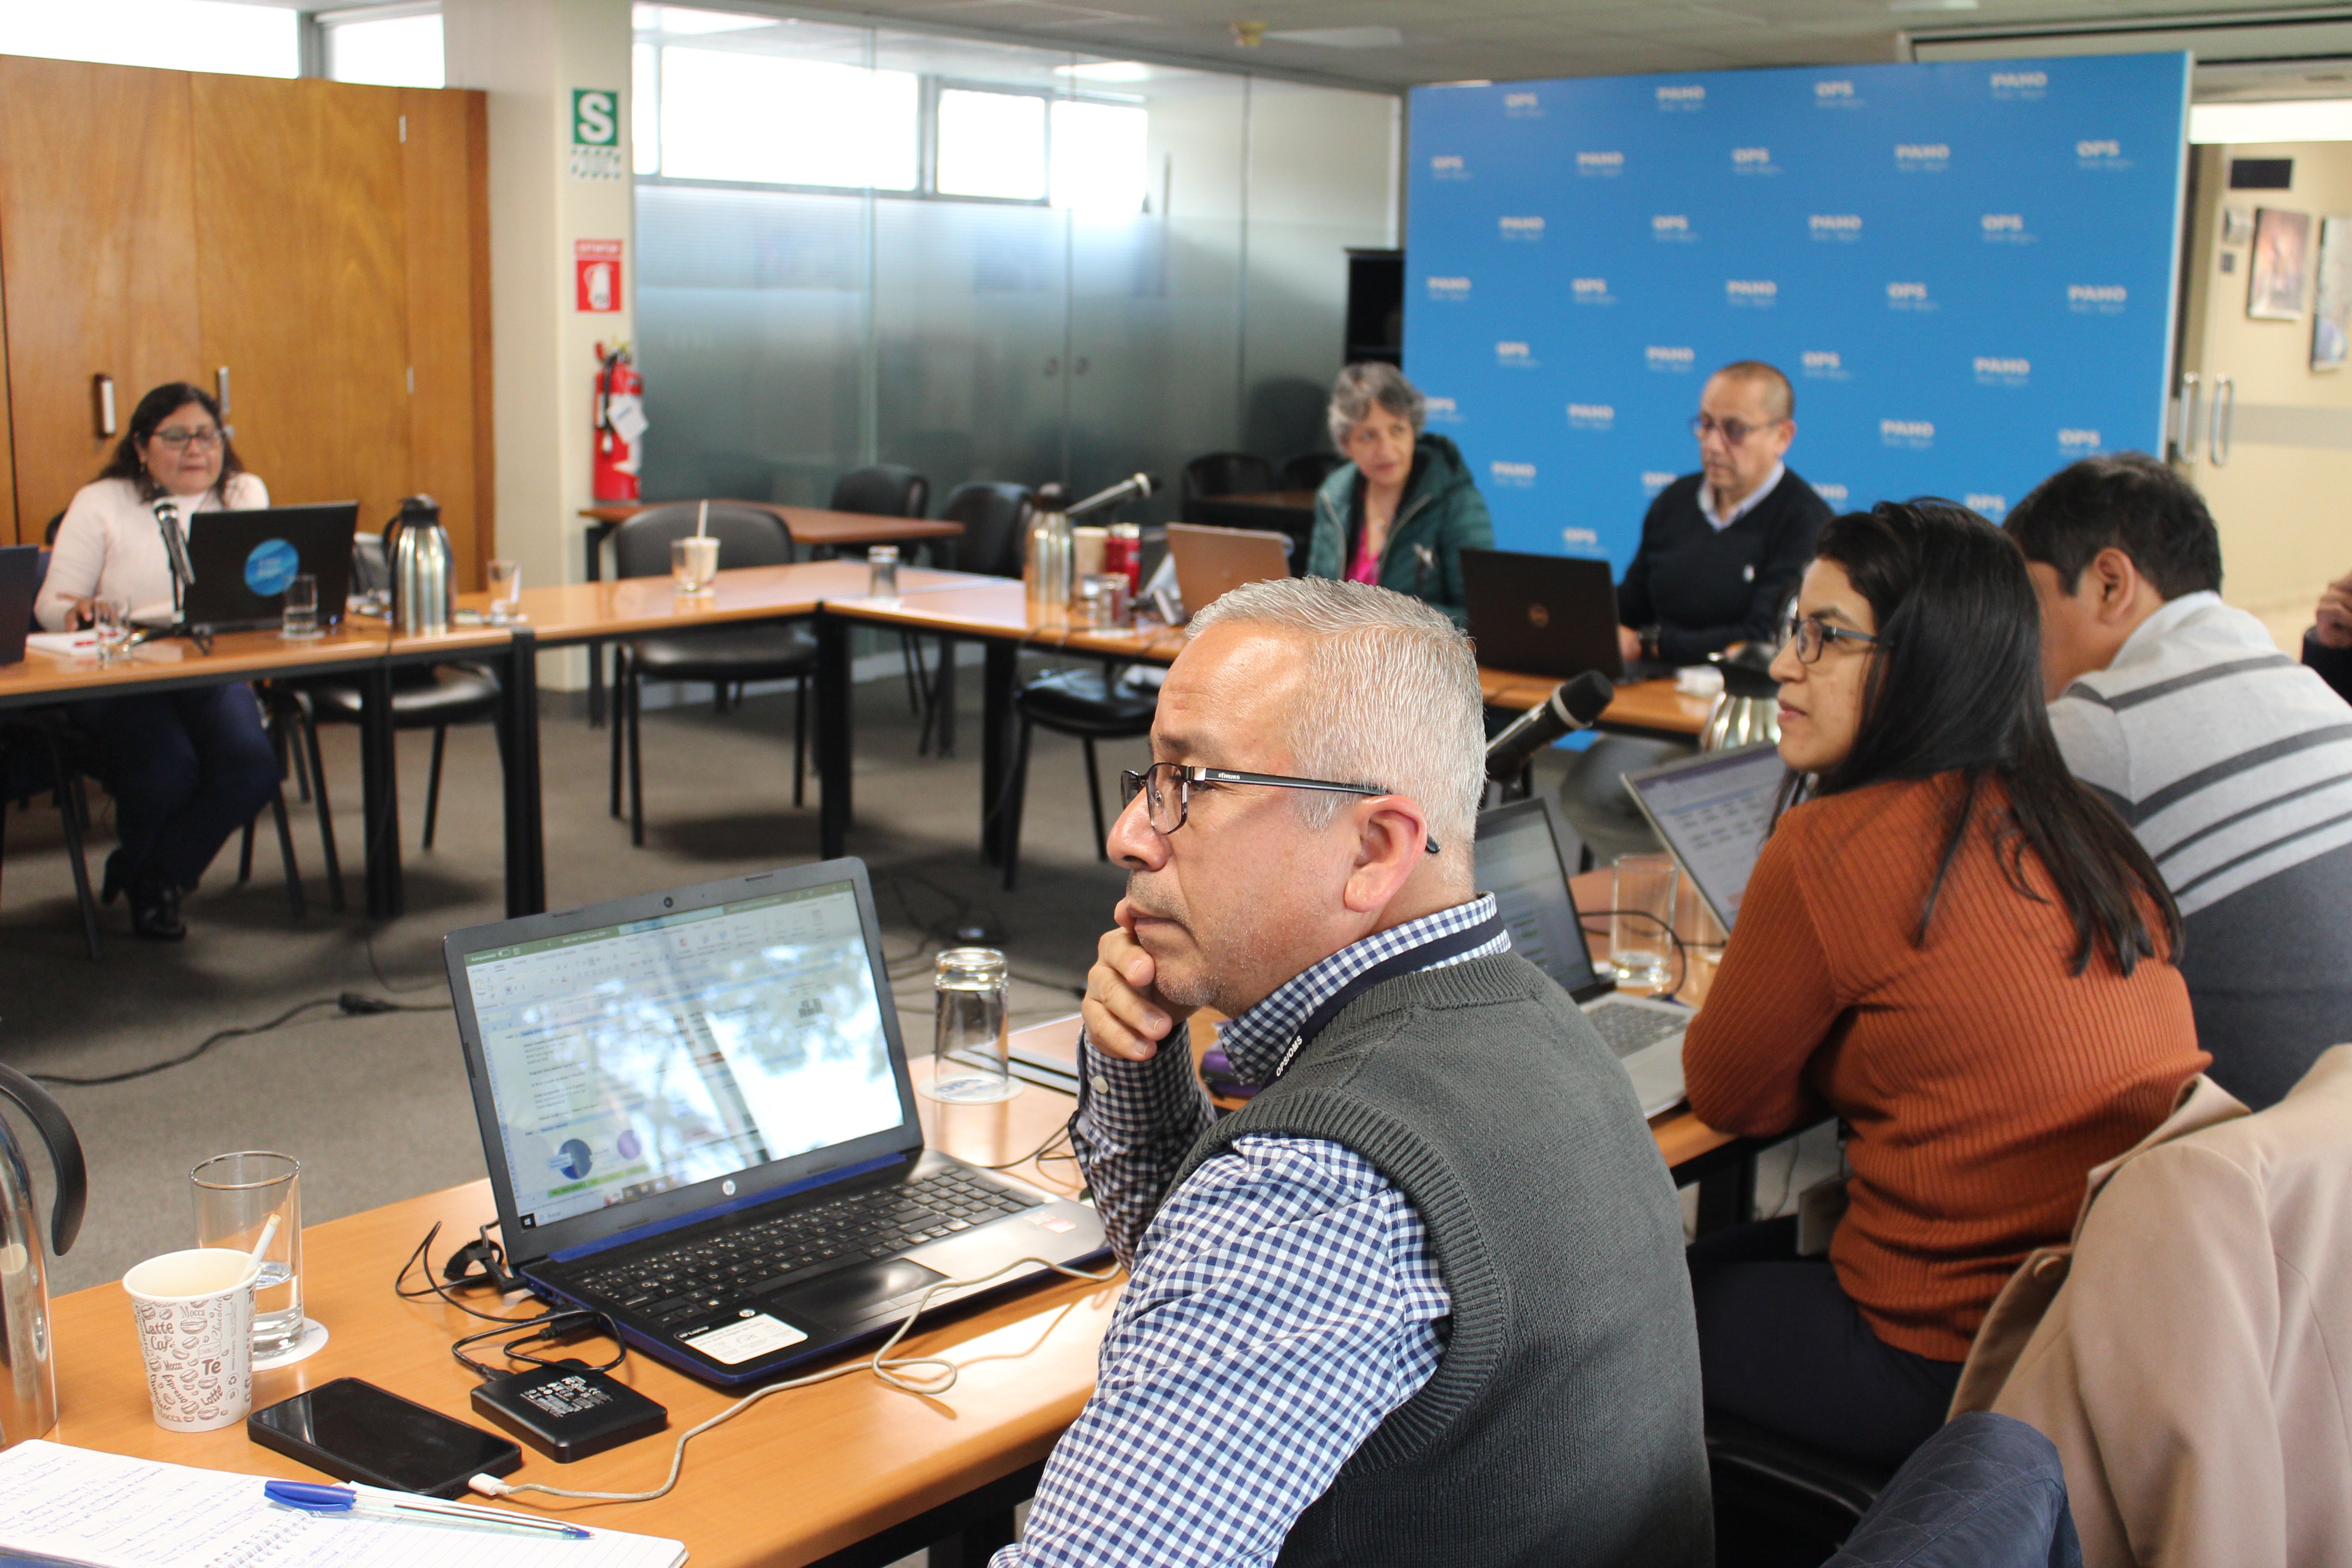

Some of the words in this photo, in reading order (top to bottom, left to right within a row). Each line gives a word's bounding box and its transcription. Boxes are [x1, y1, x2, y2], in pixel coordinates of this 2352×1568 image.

[578, 93, 614, 143] S
[180, 1306, 206, 1318] Mocca
[211, 1296, 223, 1340] Chocolat
[142, 1318, 174, 1334] Latte
[151, 1335, 178, 1352] Café
[201, 1356, 221, 1376] Té
[201, 1385, 223, 1406] Latte
